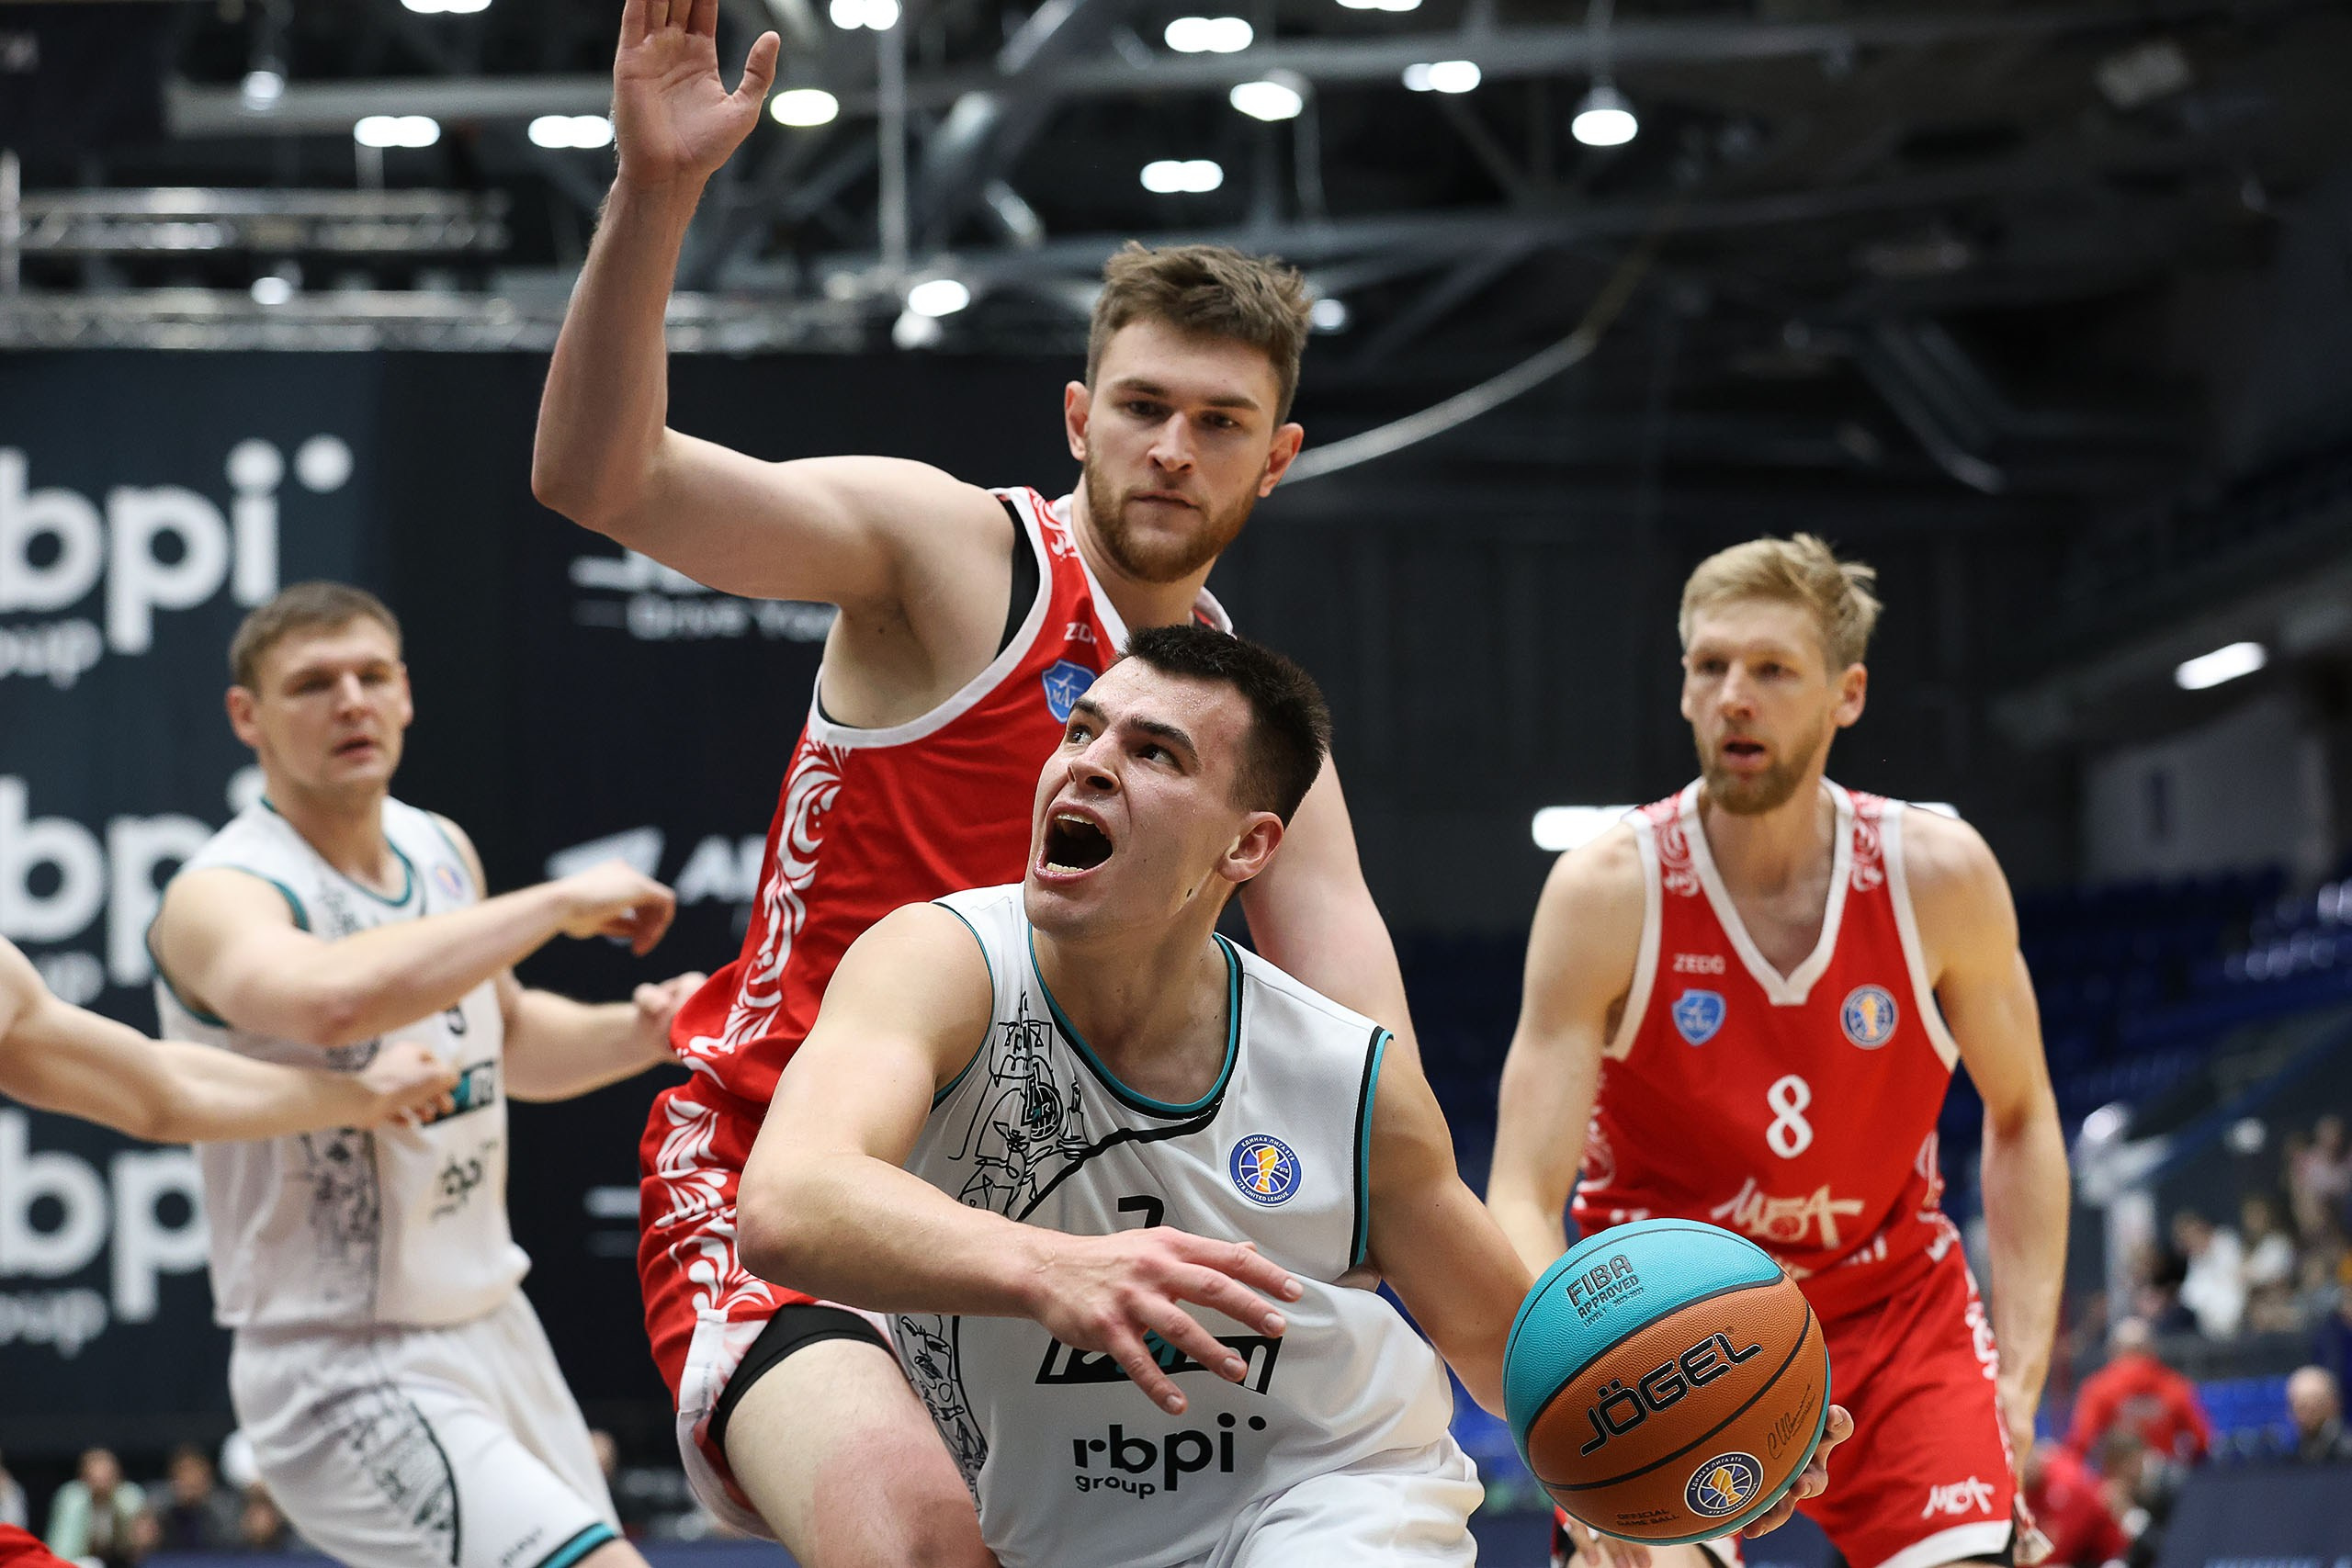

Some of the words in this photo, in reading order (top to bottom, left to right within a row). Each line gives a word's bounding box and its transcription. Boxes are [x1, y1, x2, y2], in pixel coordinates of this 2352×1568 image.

[1766, 1074, 1814, 1160] 8
[1566, 1255, 1634, 1307] FIBA
[1577, 1275, 1639, 1319] APPROVED
[1579, 1332, 1763, 1457] JÖGEL
[1075, 1475, 1156, 1499] group
